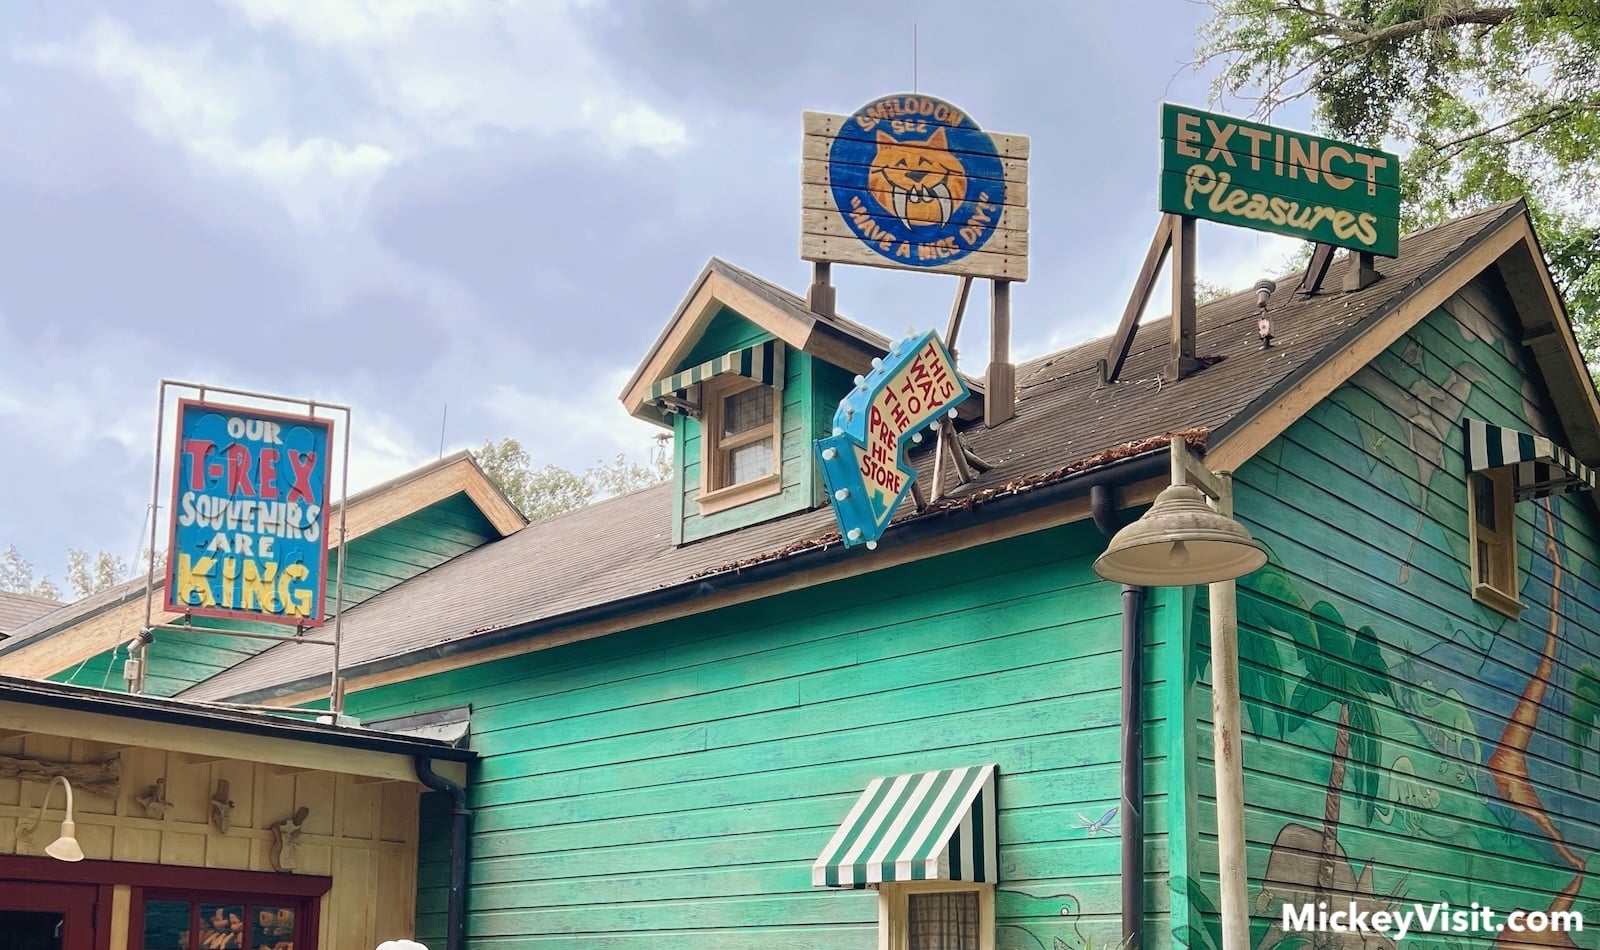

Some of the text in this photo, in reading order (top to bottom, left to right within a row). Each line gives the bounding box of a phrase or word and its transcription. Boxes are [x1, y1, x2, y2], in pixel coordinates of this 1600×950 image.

[856, 97, 964, 132] SMILODON
[891, 119, 928, 134] SEZ
[1177, 113, 1387, 197] EXTINCT
[1184, 163, 1377, 245] Pleasures
[896, 240, 911, 259] A
[918, 236, 960, 261] NICE
[910, 352, 943, 411] WAY
[924, 342, 955, 400] THIS
[883, 386, 911, 434] THE
[901, 376, 921, 415] TO
[227, 416, 283, 445] OUR
[869, 405, 898, 451] PRE-
[185, 440, 317, 504] T-REX
[860, 454, 901, 495] STORE
[871, 440, 894, 464] HI-
[179, 491, 321, 542] SOUVENIRS
[206, 532, 275, 558] ARE
[177, 553, 313, 617] KING
